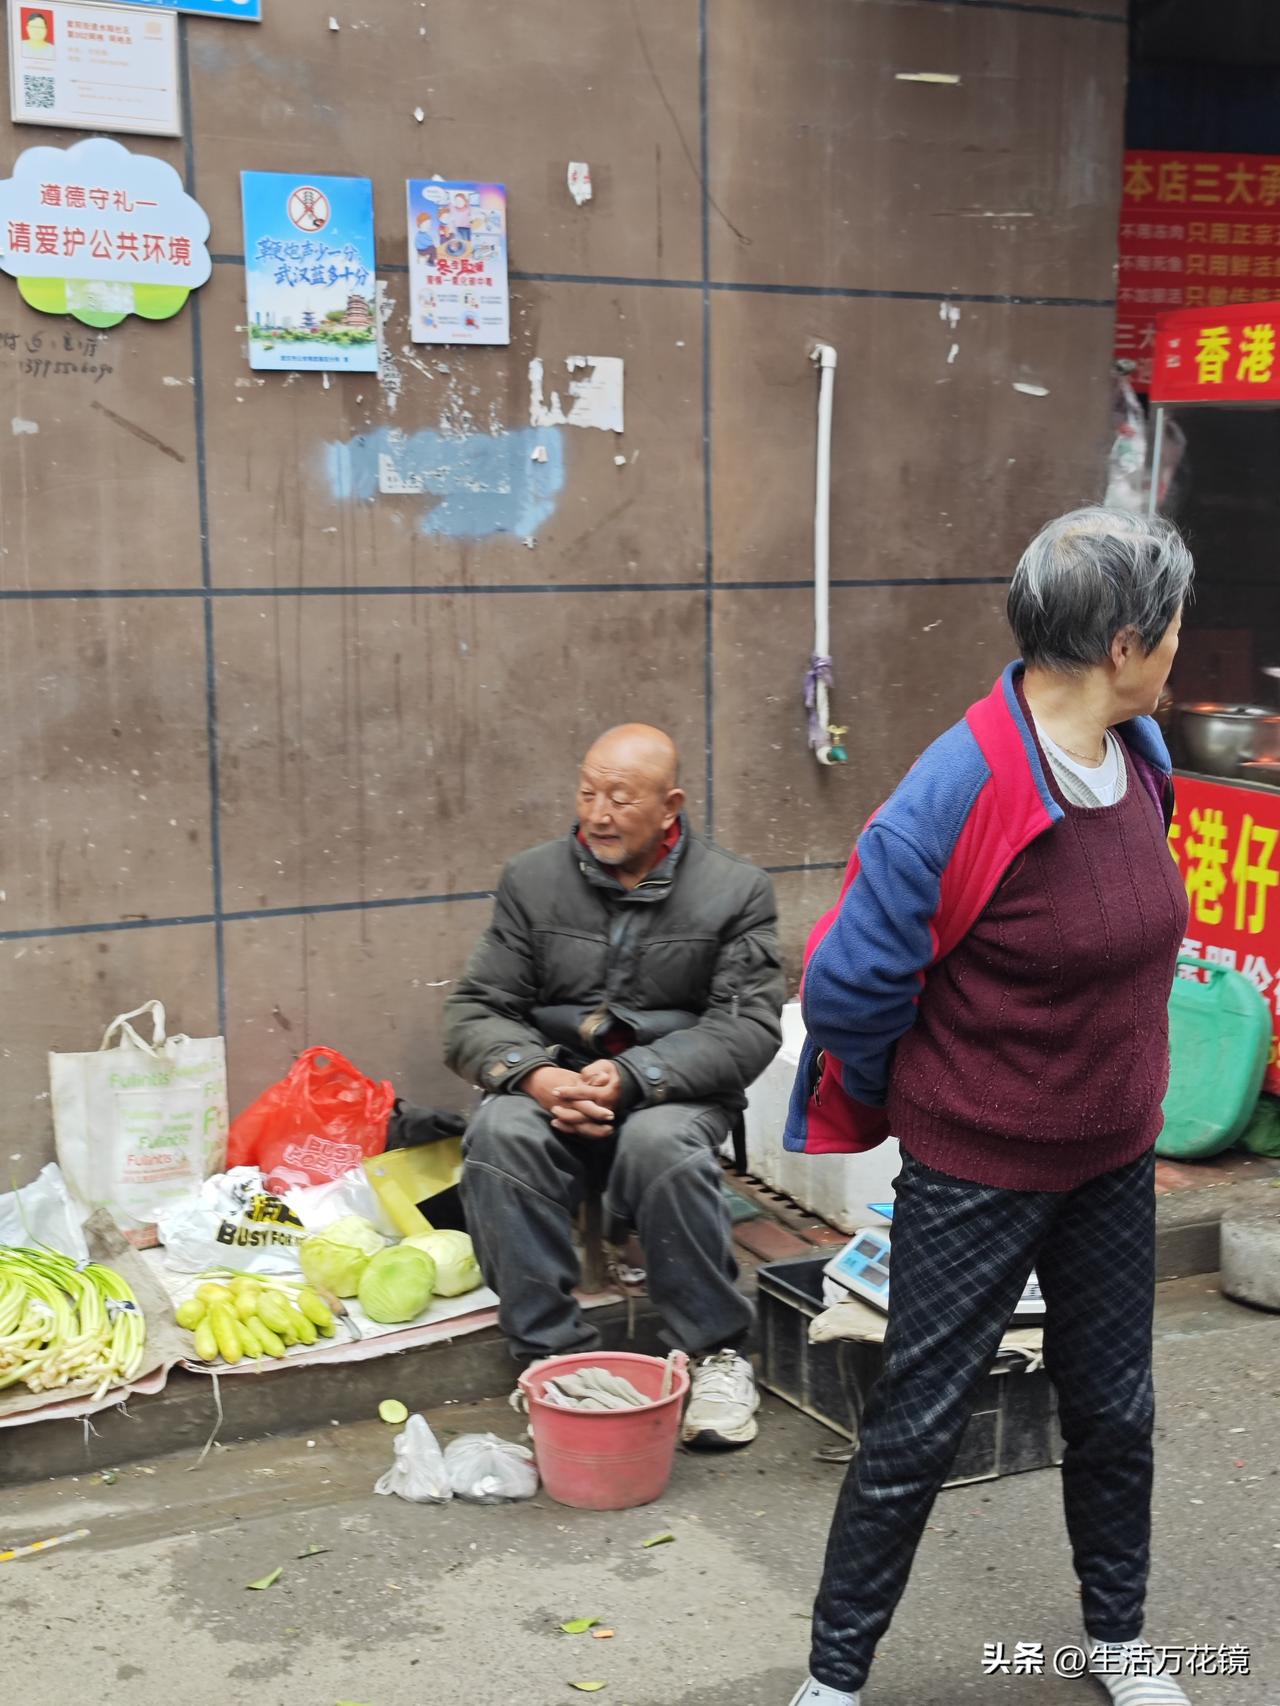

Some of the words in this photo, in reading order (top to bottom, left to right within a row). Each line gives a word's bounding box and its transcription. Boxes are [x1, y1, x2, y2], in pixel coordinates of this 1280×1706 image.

[8, 221, 191, 266] 请爱护公共环境
[255, 237, 361, 262] 鞭炮声少一分
[274, 264, 369, 287] 武汉蓝多十分
[1195, 323, 1276, 384] 香港
[1168, 797, 1279, 934] 港仔
[217, 1220, 268, 1246] BUSY
